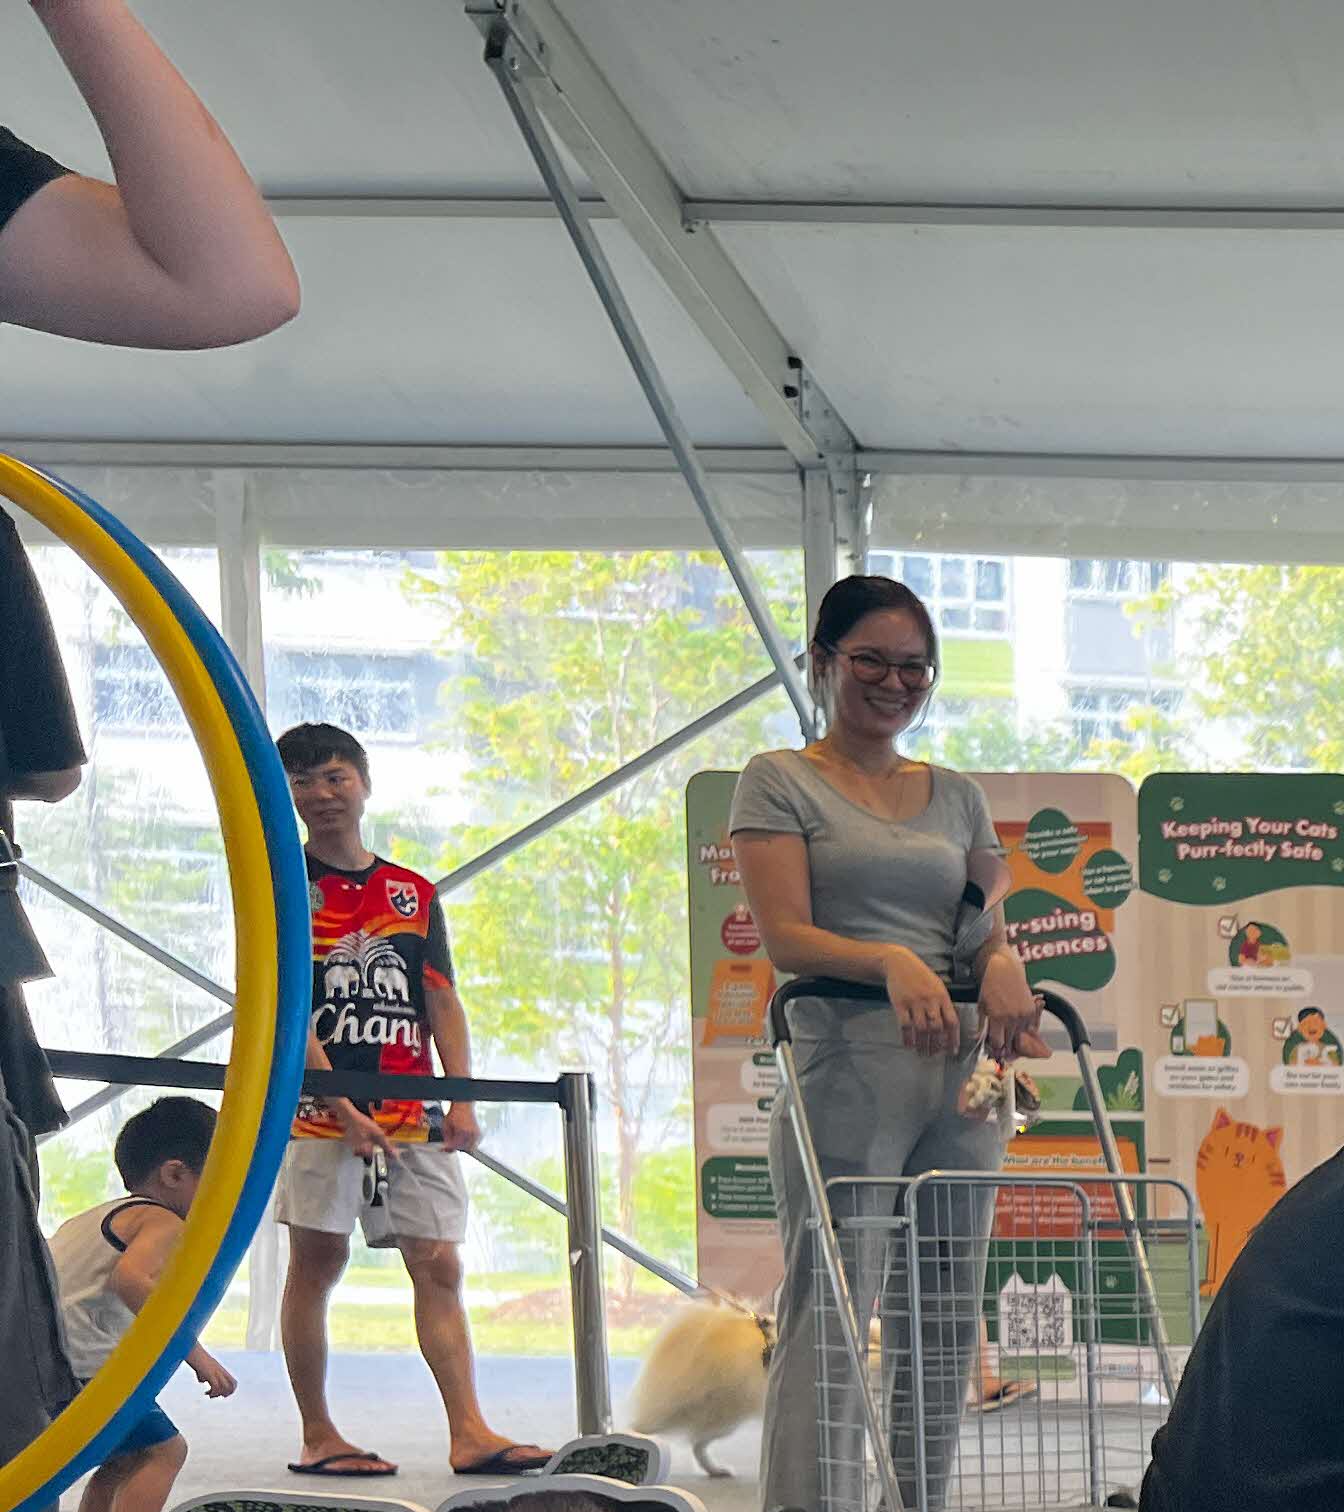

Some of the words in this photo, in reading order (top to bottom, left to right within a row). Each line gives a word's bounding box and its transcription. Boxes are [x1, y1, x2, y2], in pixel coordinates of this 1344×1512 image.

[1161, 816, 1243, 840] Keeping
[1245, 816, 1293, 836] Your
[1295, 819, 1338, 840] Cats
[1177, 838, 1277, 862] Purr-fectly
[1280, 840, 1324, 861] Safe
[1011, 935, 1108, 964] Licences
[311, 1003, 422, 1057] Chang
